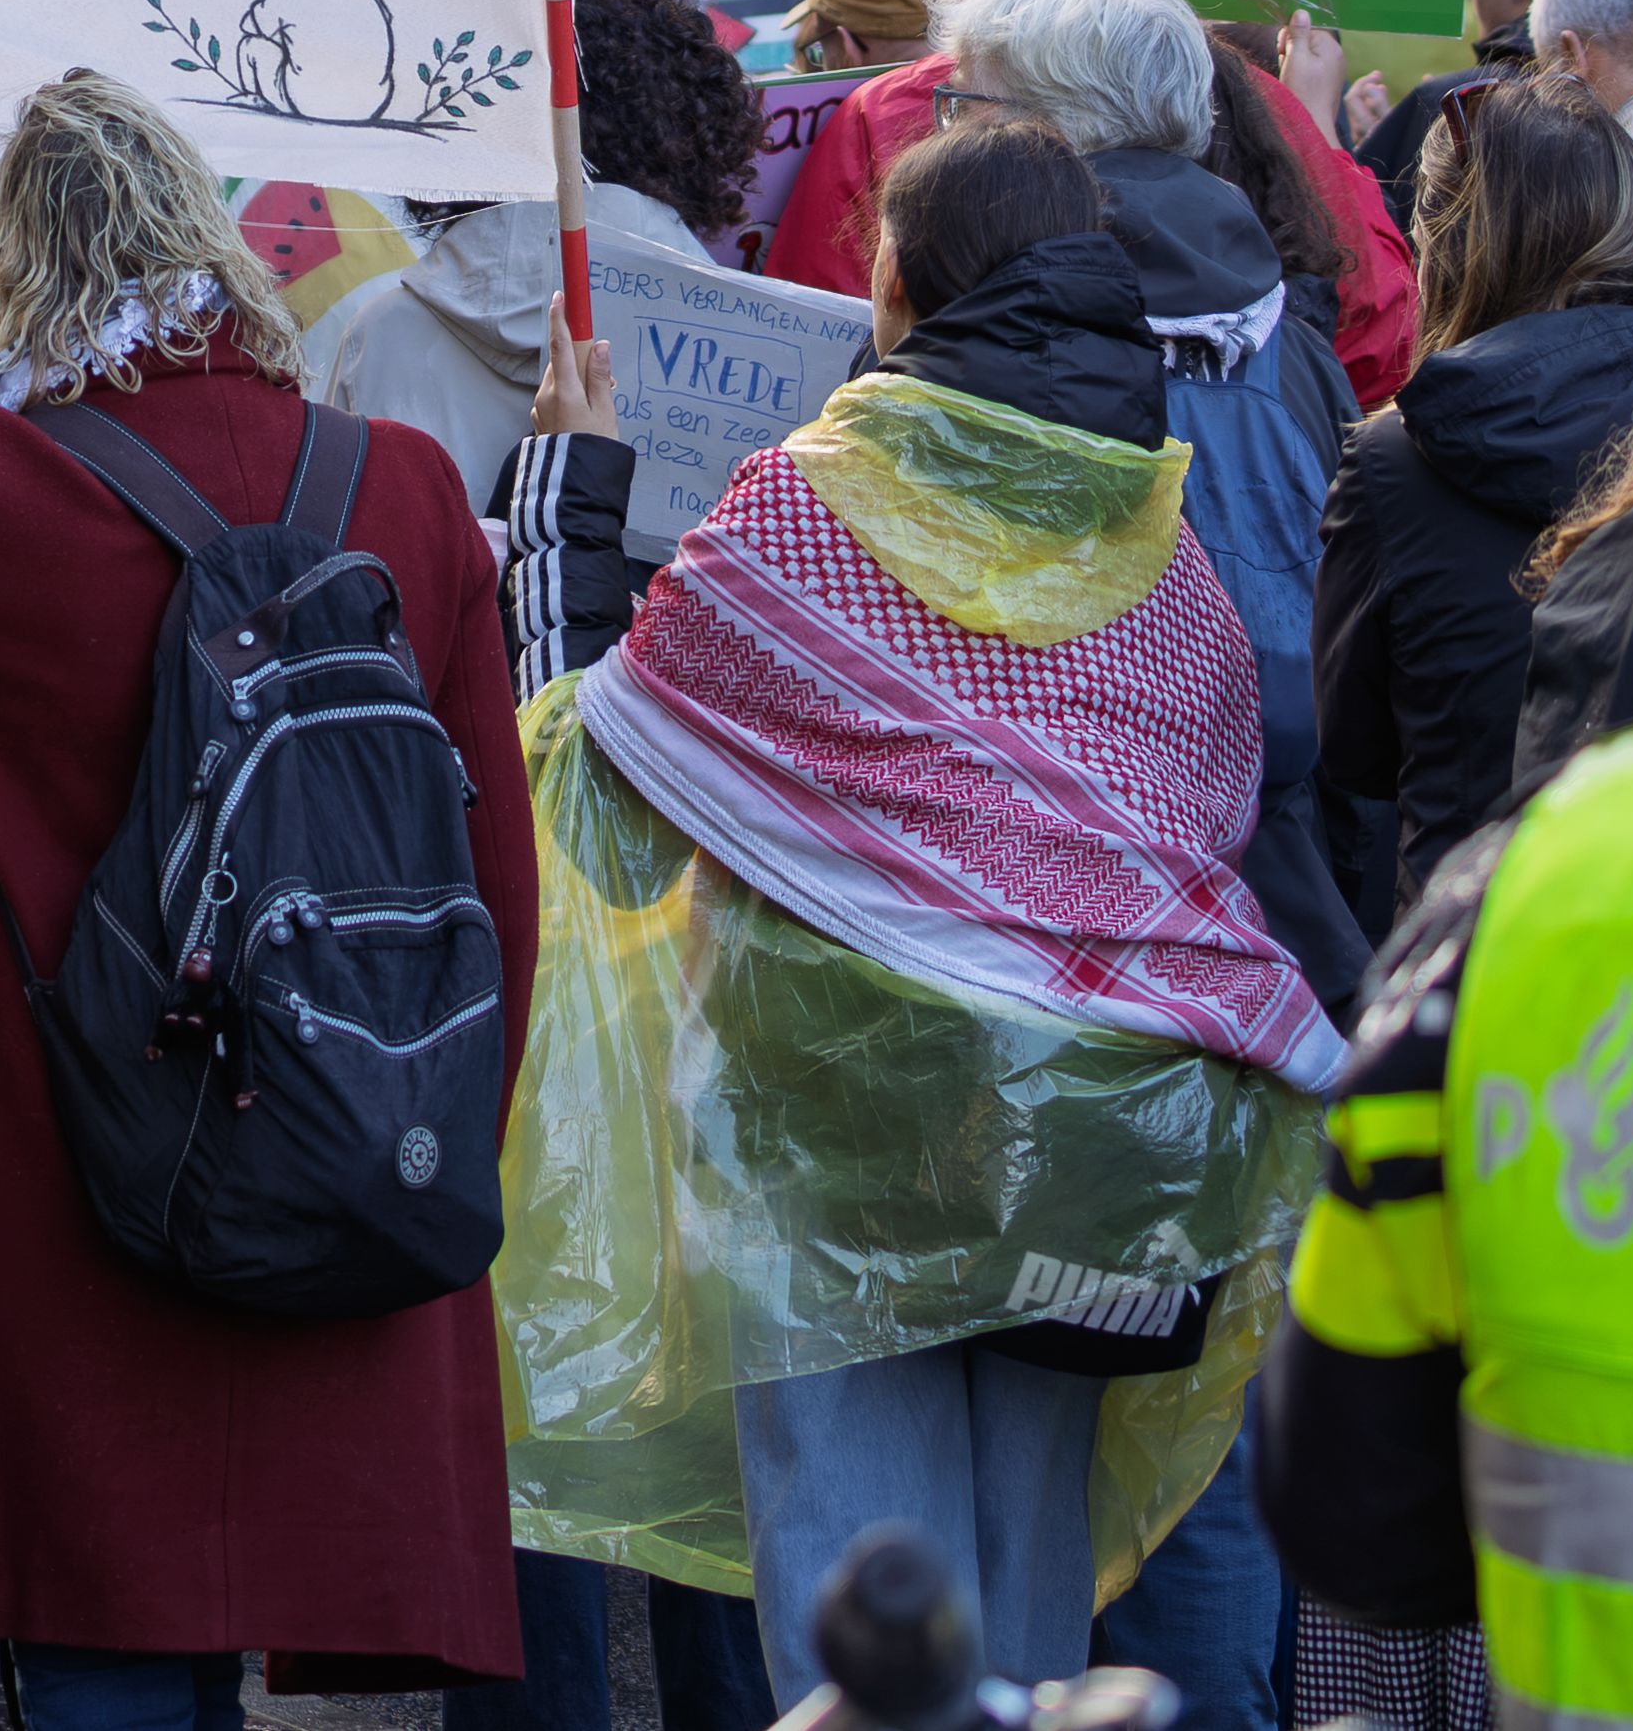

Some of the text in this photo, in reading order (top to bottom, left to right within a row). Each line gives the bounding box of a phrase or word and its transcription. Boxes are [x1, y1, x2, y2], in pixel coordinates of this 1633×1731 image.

[588, 260, 664, 301] EDERS
[679, 281, 811, 335] VERLANGEN
[648, 323, 798, 411] VREDE
[615, 392, 772, 450] als een zee
[631, 429, 708, 470] deze
[1004, 1250, 1187, 1338] PUMA
